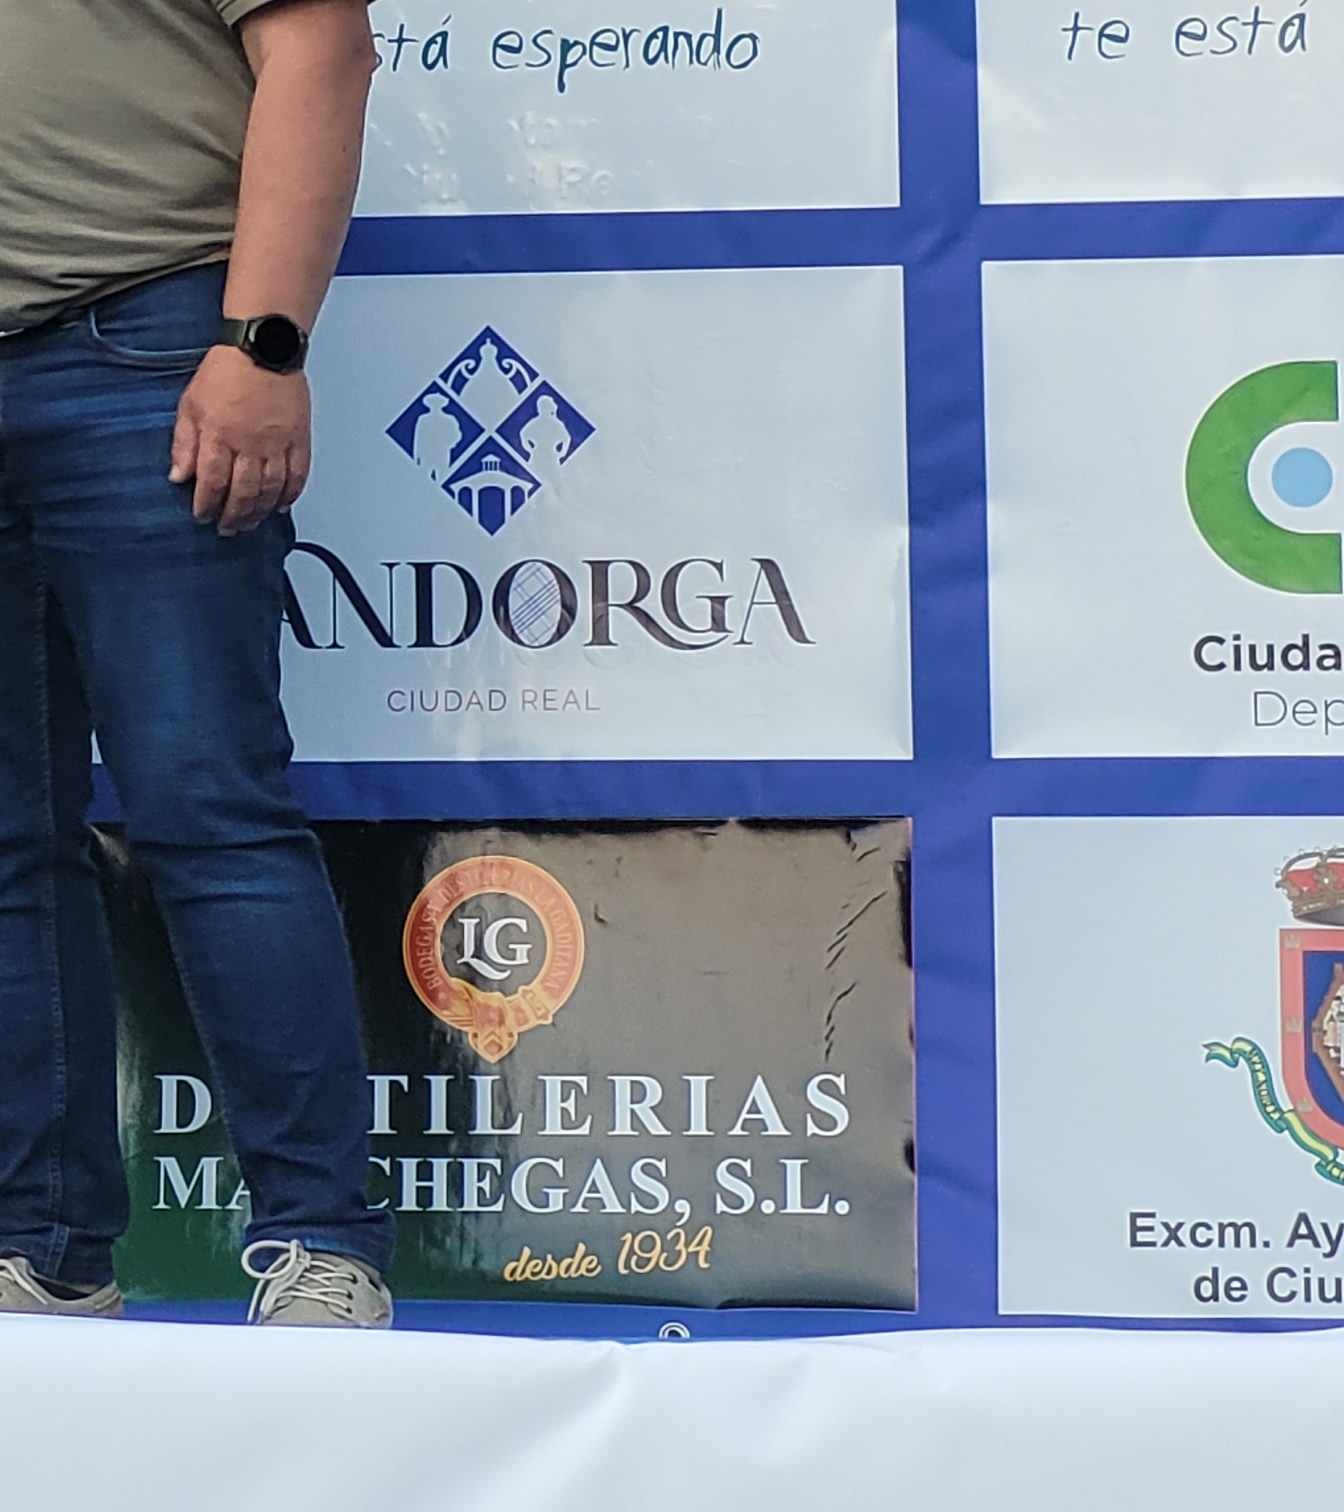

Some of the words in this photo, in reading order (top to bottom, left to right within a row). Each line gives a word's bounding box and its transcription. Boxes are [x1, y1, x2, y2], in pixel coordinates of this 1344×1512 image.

[491, 9, 760, 94] esperando
[1061, 11, 1131, 61] te
[1193, 634, 1342, 672] Ciuda
[386, 690, 507, 713] CIUDAD
[521, 688, 601, 713] REAL
[456, 917, 533, 981] LG
[546, 907, 573, 991] GADITANA
[152, 1071, 852, 1138] DTILERIAS
[714, 1158, 851, 1216] S.L.
[503, 1243, 602, 1284] desde
[619, 1225, 713, 1276] 1934
[1128, 1211, 1271, 1249] Excm.
[1193, 1267, 1249, 1304] de
